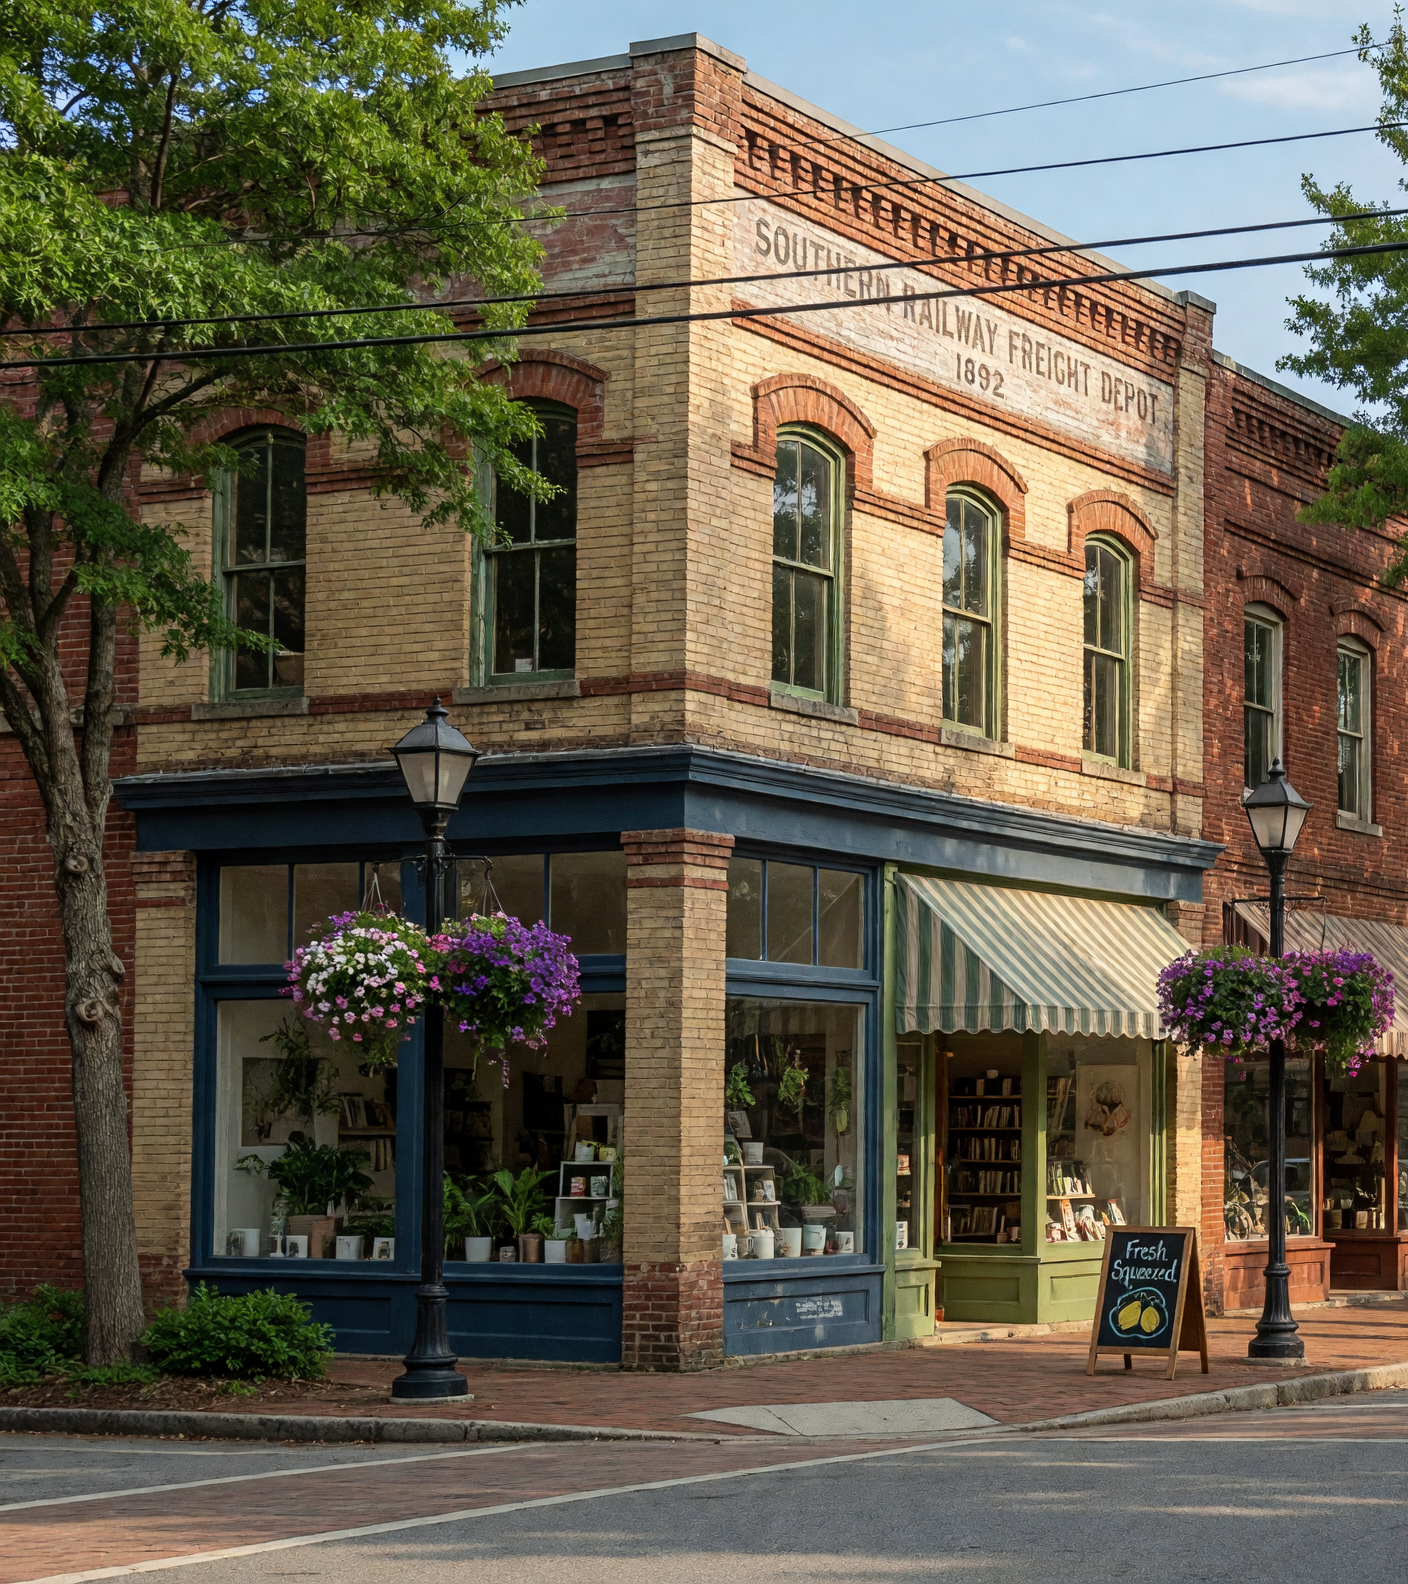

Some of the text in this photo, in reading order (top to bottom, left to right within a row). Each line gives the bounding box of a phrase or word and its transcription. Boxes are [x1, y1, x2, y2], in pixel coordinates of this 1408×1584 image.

[756, 217, 1159, 425] SOUTHERN RAILWAY FREIGHT DEPOT
[956, 352, 1005, 400] 1892
[1126, 1239, 1168, 1261] Fresh
[1111, 1259, 1178, 1290] Squeezed
